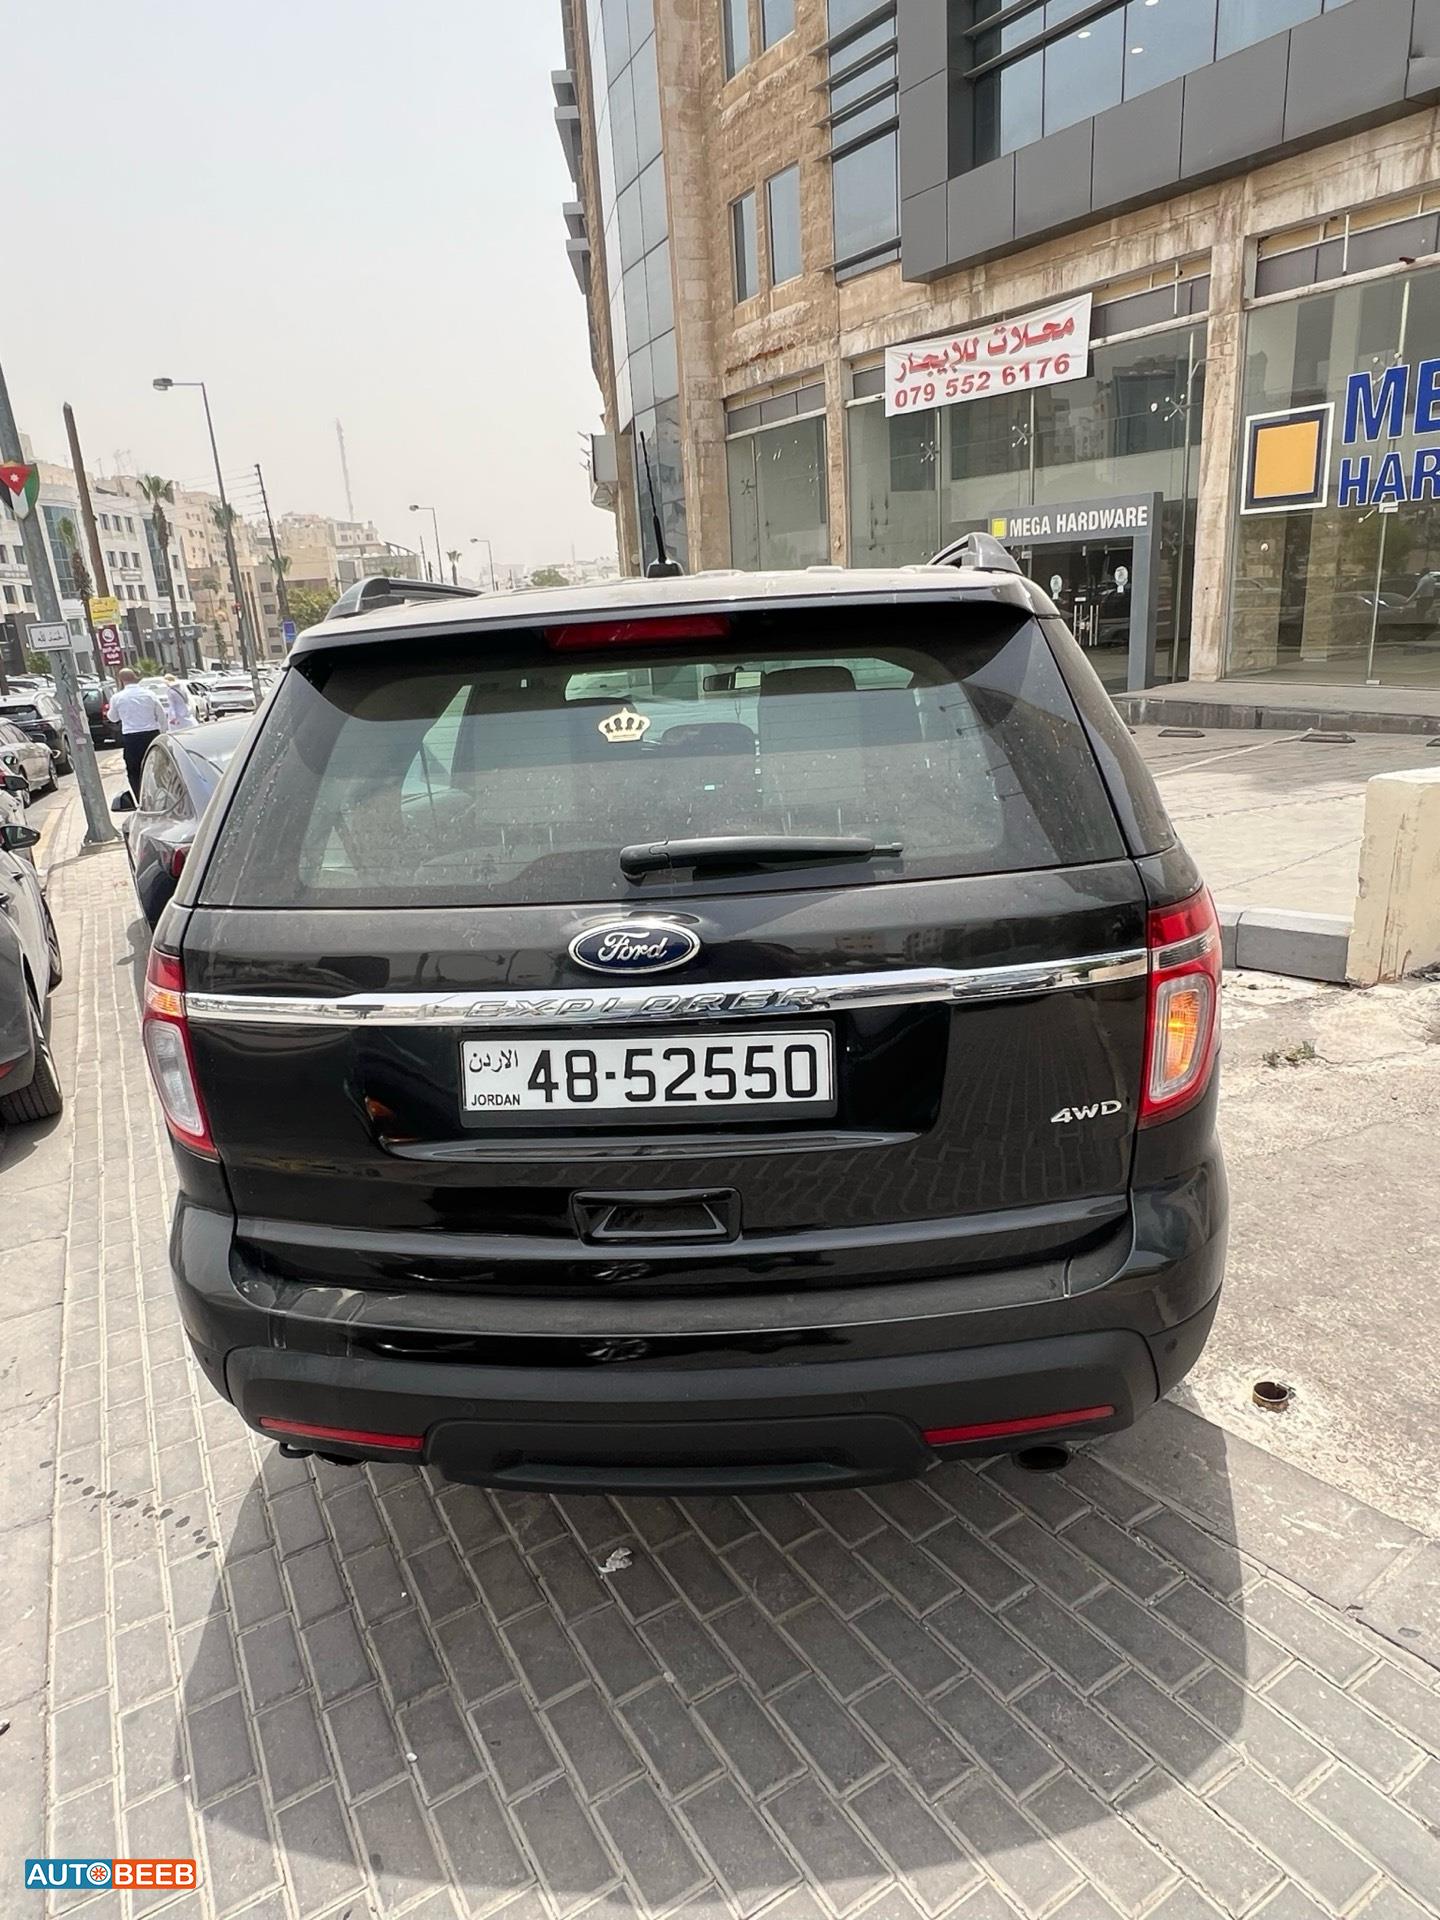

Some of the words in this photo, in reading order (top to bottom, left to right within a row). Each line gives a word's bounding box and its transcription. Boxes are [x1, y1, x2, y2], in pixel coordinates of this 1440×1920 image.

[987, 317, 1076, 357] محلات
[894, 383, 936, 409] 079
[945, 371, 991, 398] 552
[1002, 352, 1071, 386] 6176
[1342, 357, 1440, 446] ME
[1009, 515, 1051, 537] MEGA
[1056, 505, 1149, 533] HARDWARE
[597, 931, 669, 962] Ford
[463, 986, 824, 1019] EXPLORER
[469, 1049, 519, 1073] الاردن
[471, 1094, 521, 1106] JORDAN
[1051, 1100, 1122, 1123] 4WD
